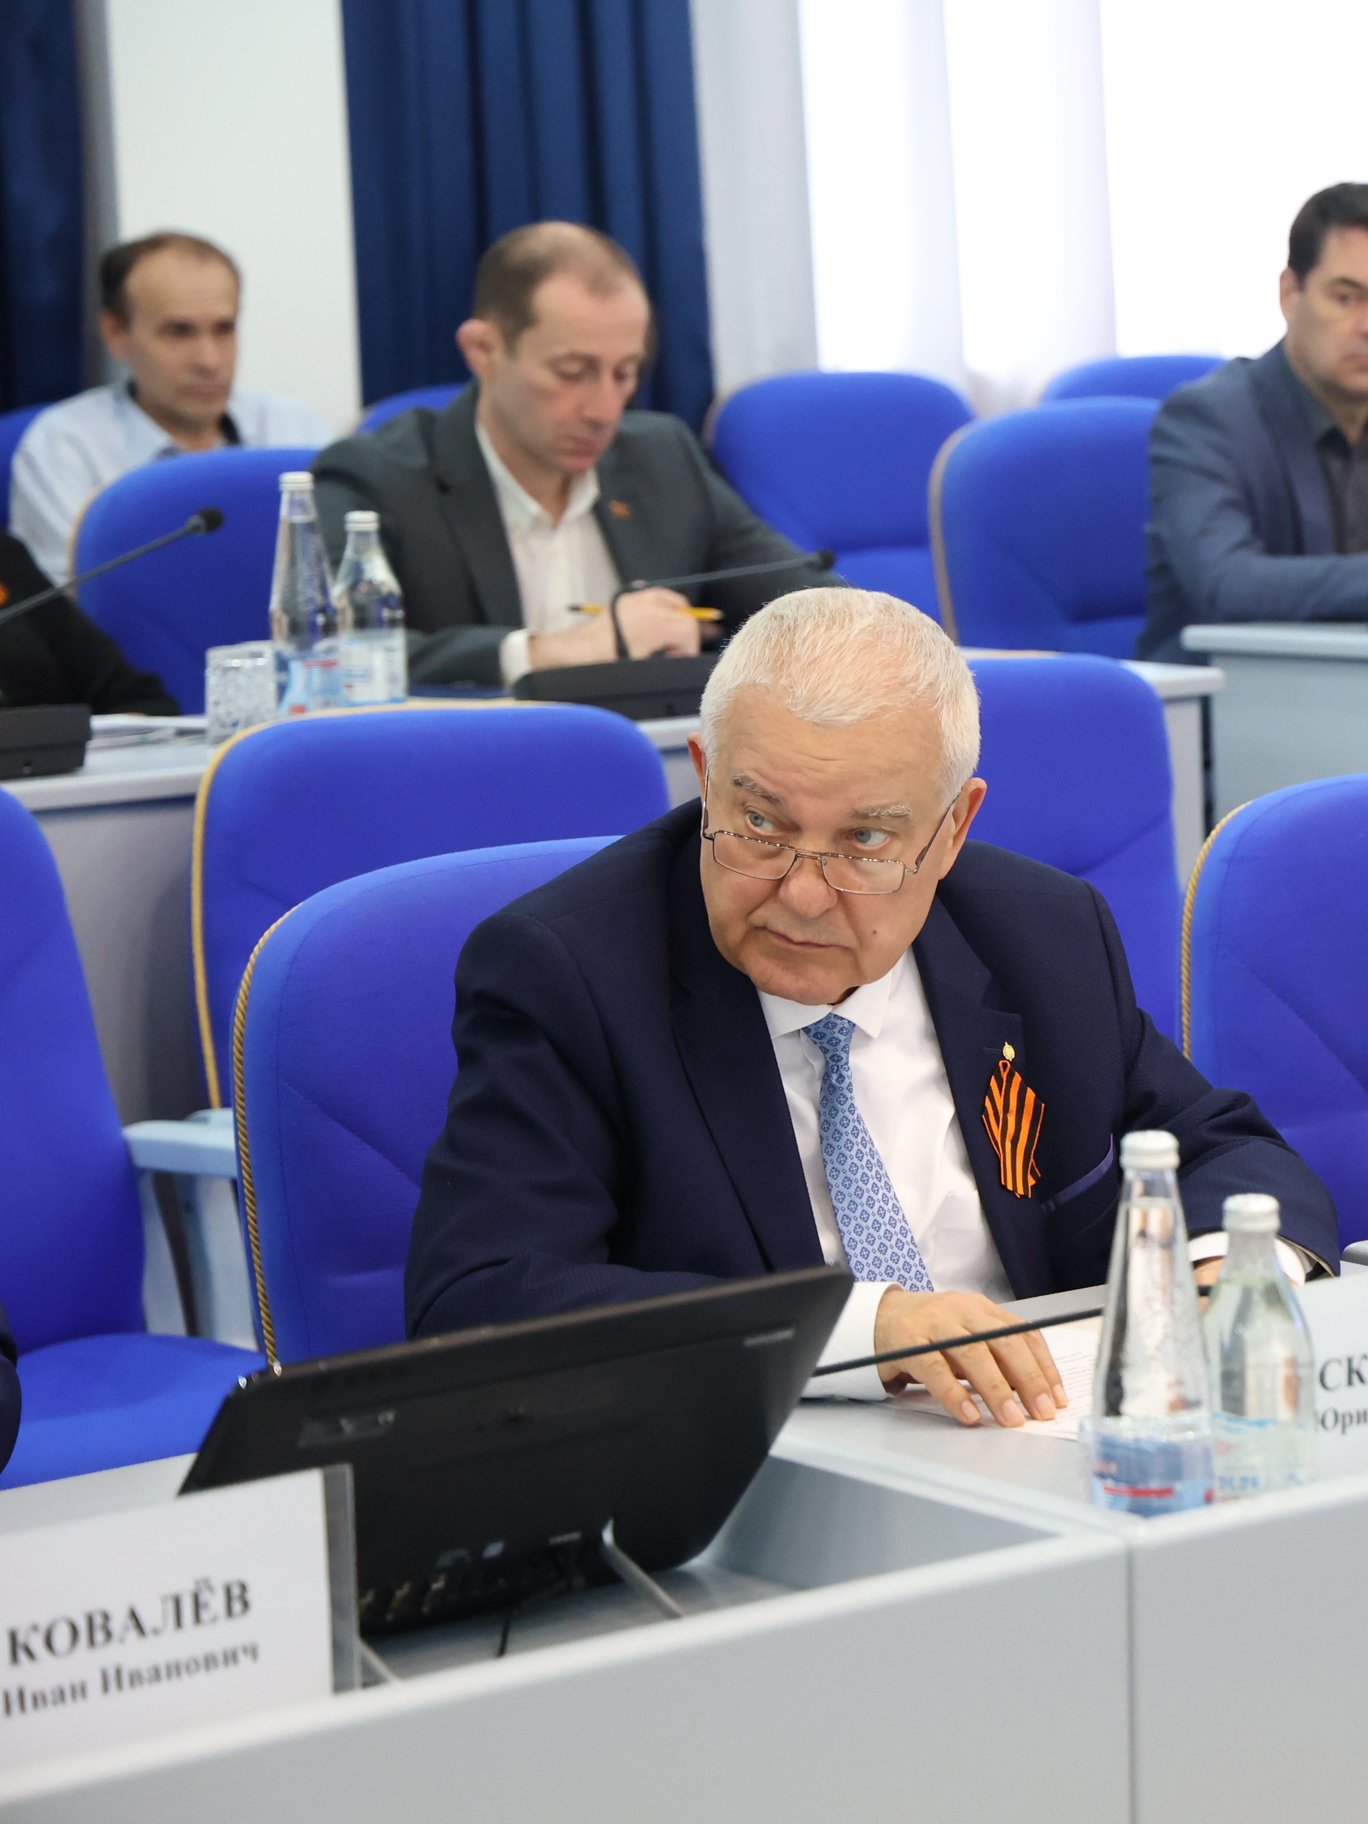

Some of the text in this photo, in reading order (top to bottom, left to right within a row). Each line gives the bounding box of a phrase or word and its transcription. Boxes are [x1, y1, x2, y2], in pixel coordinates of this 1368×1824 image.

[8, 1577, 251, 1667] КОВАЛЁВ
[3, 1643, 258, 1717] Иван Иванович
